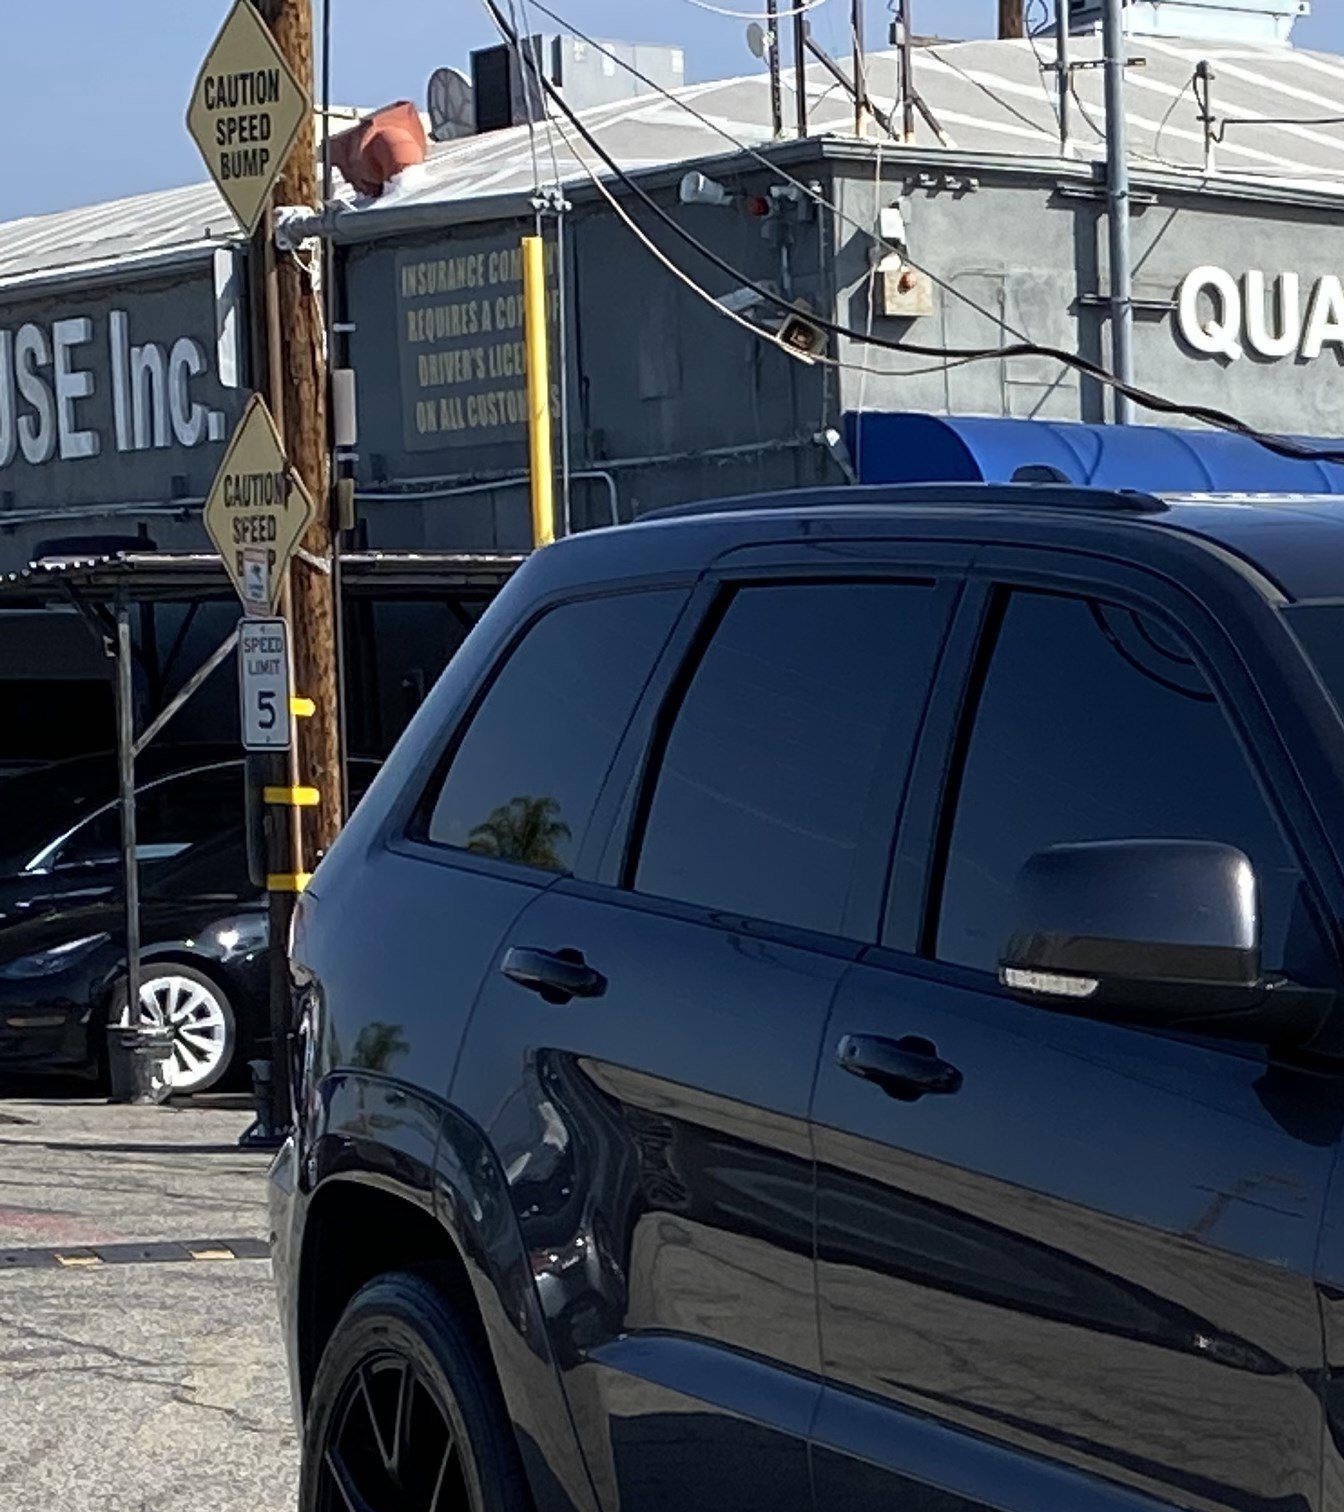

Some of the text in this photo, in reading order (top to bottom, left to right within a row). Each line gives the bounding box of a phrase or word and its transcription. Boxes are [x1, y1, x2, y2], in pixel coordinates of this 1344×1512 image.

[204, 69, 281, 110] CAUTION
[216, 113, 271, 145] SPEED
[220, 148, 270, 180] BUMP
[402, 253, 485, 298] INSURANCE
[407, 300, 479, 343] REQUIRES
[481, 299, 492, 332] A
[109, 309, 226, 451] Inc.
[418, 347, 485, 388] DRIVER'S
[416, 383, 561, 434] ON ALL CUSTOMS
[224, 472, 287, 508] CAUTION
[233, 514, 277, 544] SPEED
[243, 635, 284, 653] SPEED
[248, 660, 281, 675] LIMIT
[257, 690, 276, 729] 5
